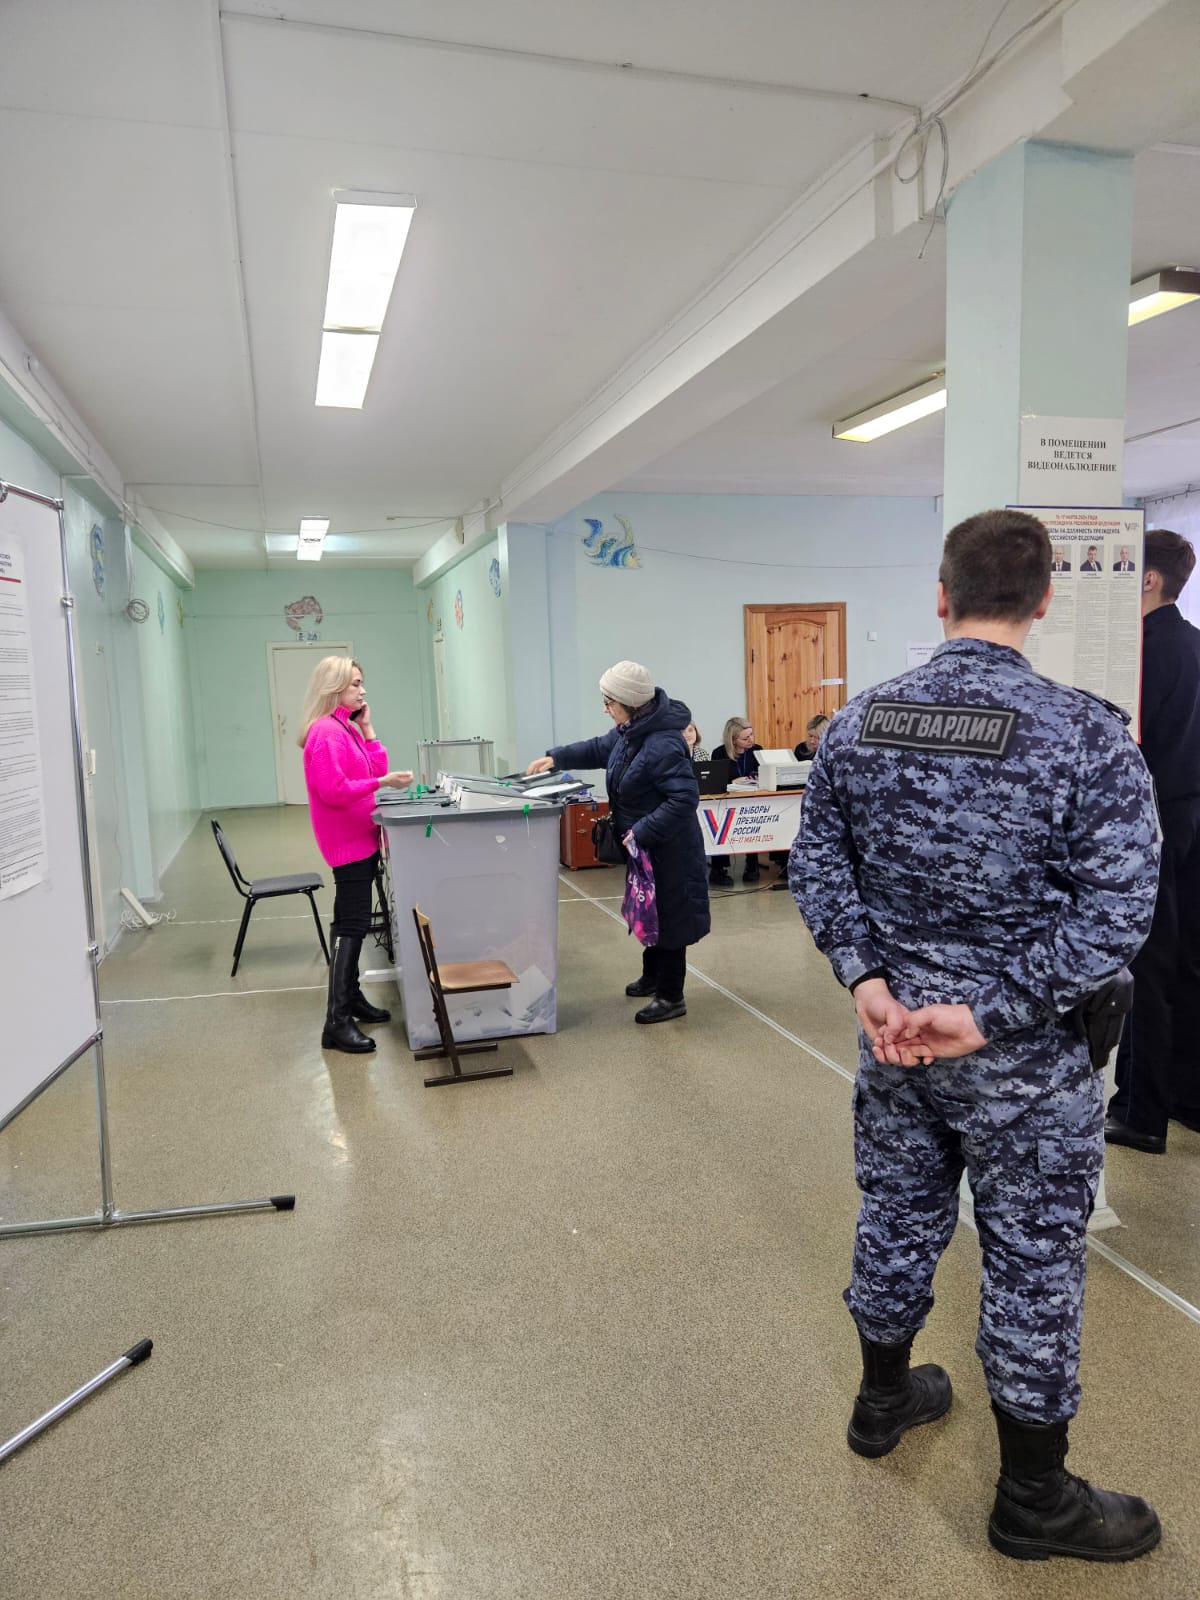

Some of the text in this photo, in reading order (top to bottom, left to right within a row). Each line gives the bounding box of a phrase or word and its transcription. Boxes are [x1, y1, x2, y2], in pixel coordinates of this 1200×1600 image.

[1040, 438, 1106, 449] В ПОМЕЩЕНИИ
[1054, 450, 1093, 460] ВЕДЕТСЯ
[1027, 460, 1117, 472] ВИДЕОНАБЛЮДЕНИЕ
[869, 709, 1003, 743] РОСГВАРДИЯ
[739, 805, 770, 815] ВЫБОРЫ
[736, 814, 779, 825] ПРЕЗИДЕНТА
[732, 826, 761, 835] РОССИИ
[744, 835, 761, 843] МАРТА
[761, 834, 774, 842] 2024
